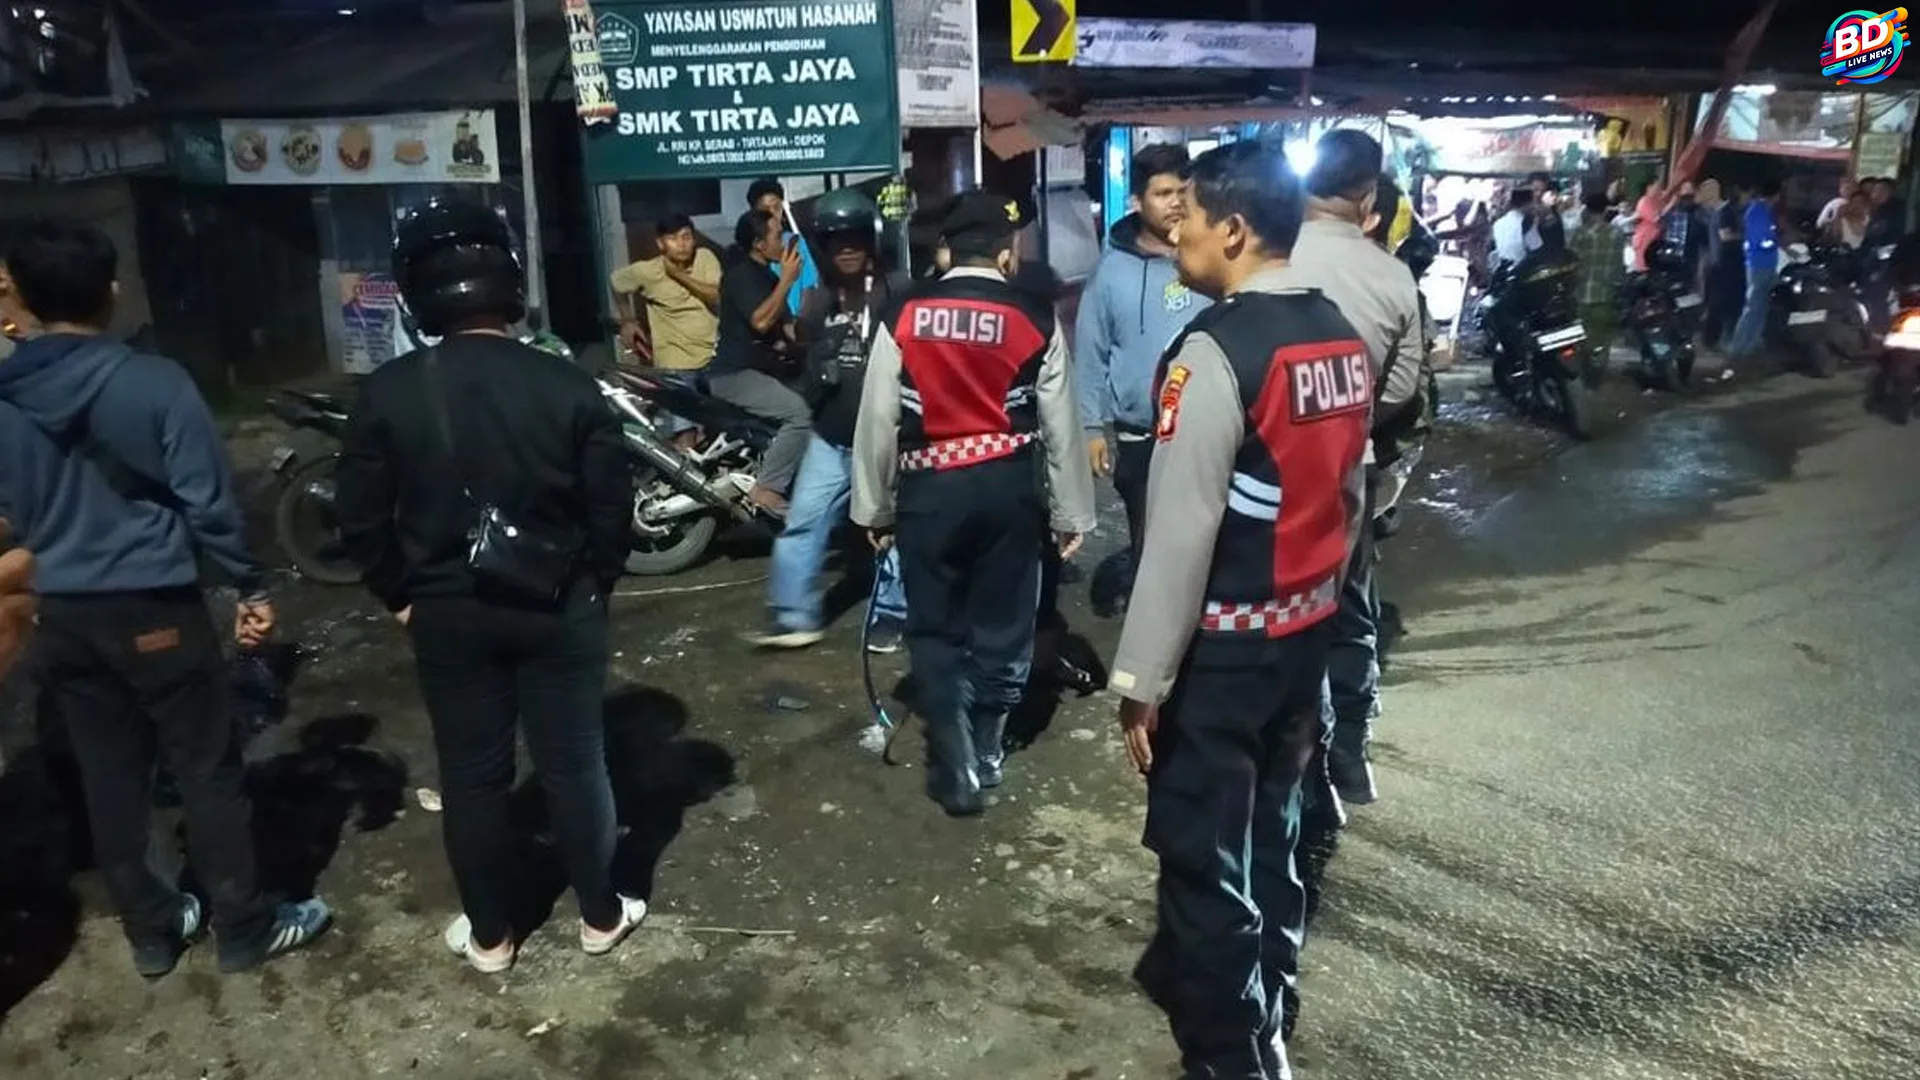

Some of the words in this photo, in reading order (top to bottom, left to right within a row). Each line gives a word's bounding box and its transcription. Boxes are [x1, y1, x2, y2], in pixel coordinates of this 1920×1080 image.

[645, 10, 716, 34] YAYASAN
[720, 6, 797, 31] USWATUN
[801, 2, 877, 28] HASANAH
[651, 41, 762, 57] MENYELENGGARAKAN
[764, 39, 826, 53] PENDIDIKAN
[615, 66, 678, 90] SMP
[687, 62, 774, 88] TIRTA
[782, 57, 856, 84] JAYA
[733, 90, 743, 104] &
[617, 110, 683, 135] SMK
[690, 107, 779, 132] TIRTA
[787, 103, 860, 128] JAYA
[914, 307, 1004, 344] POLISI
